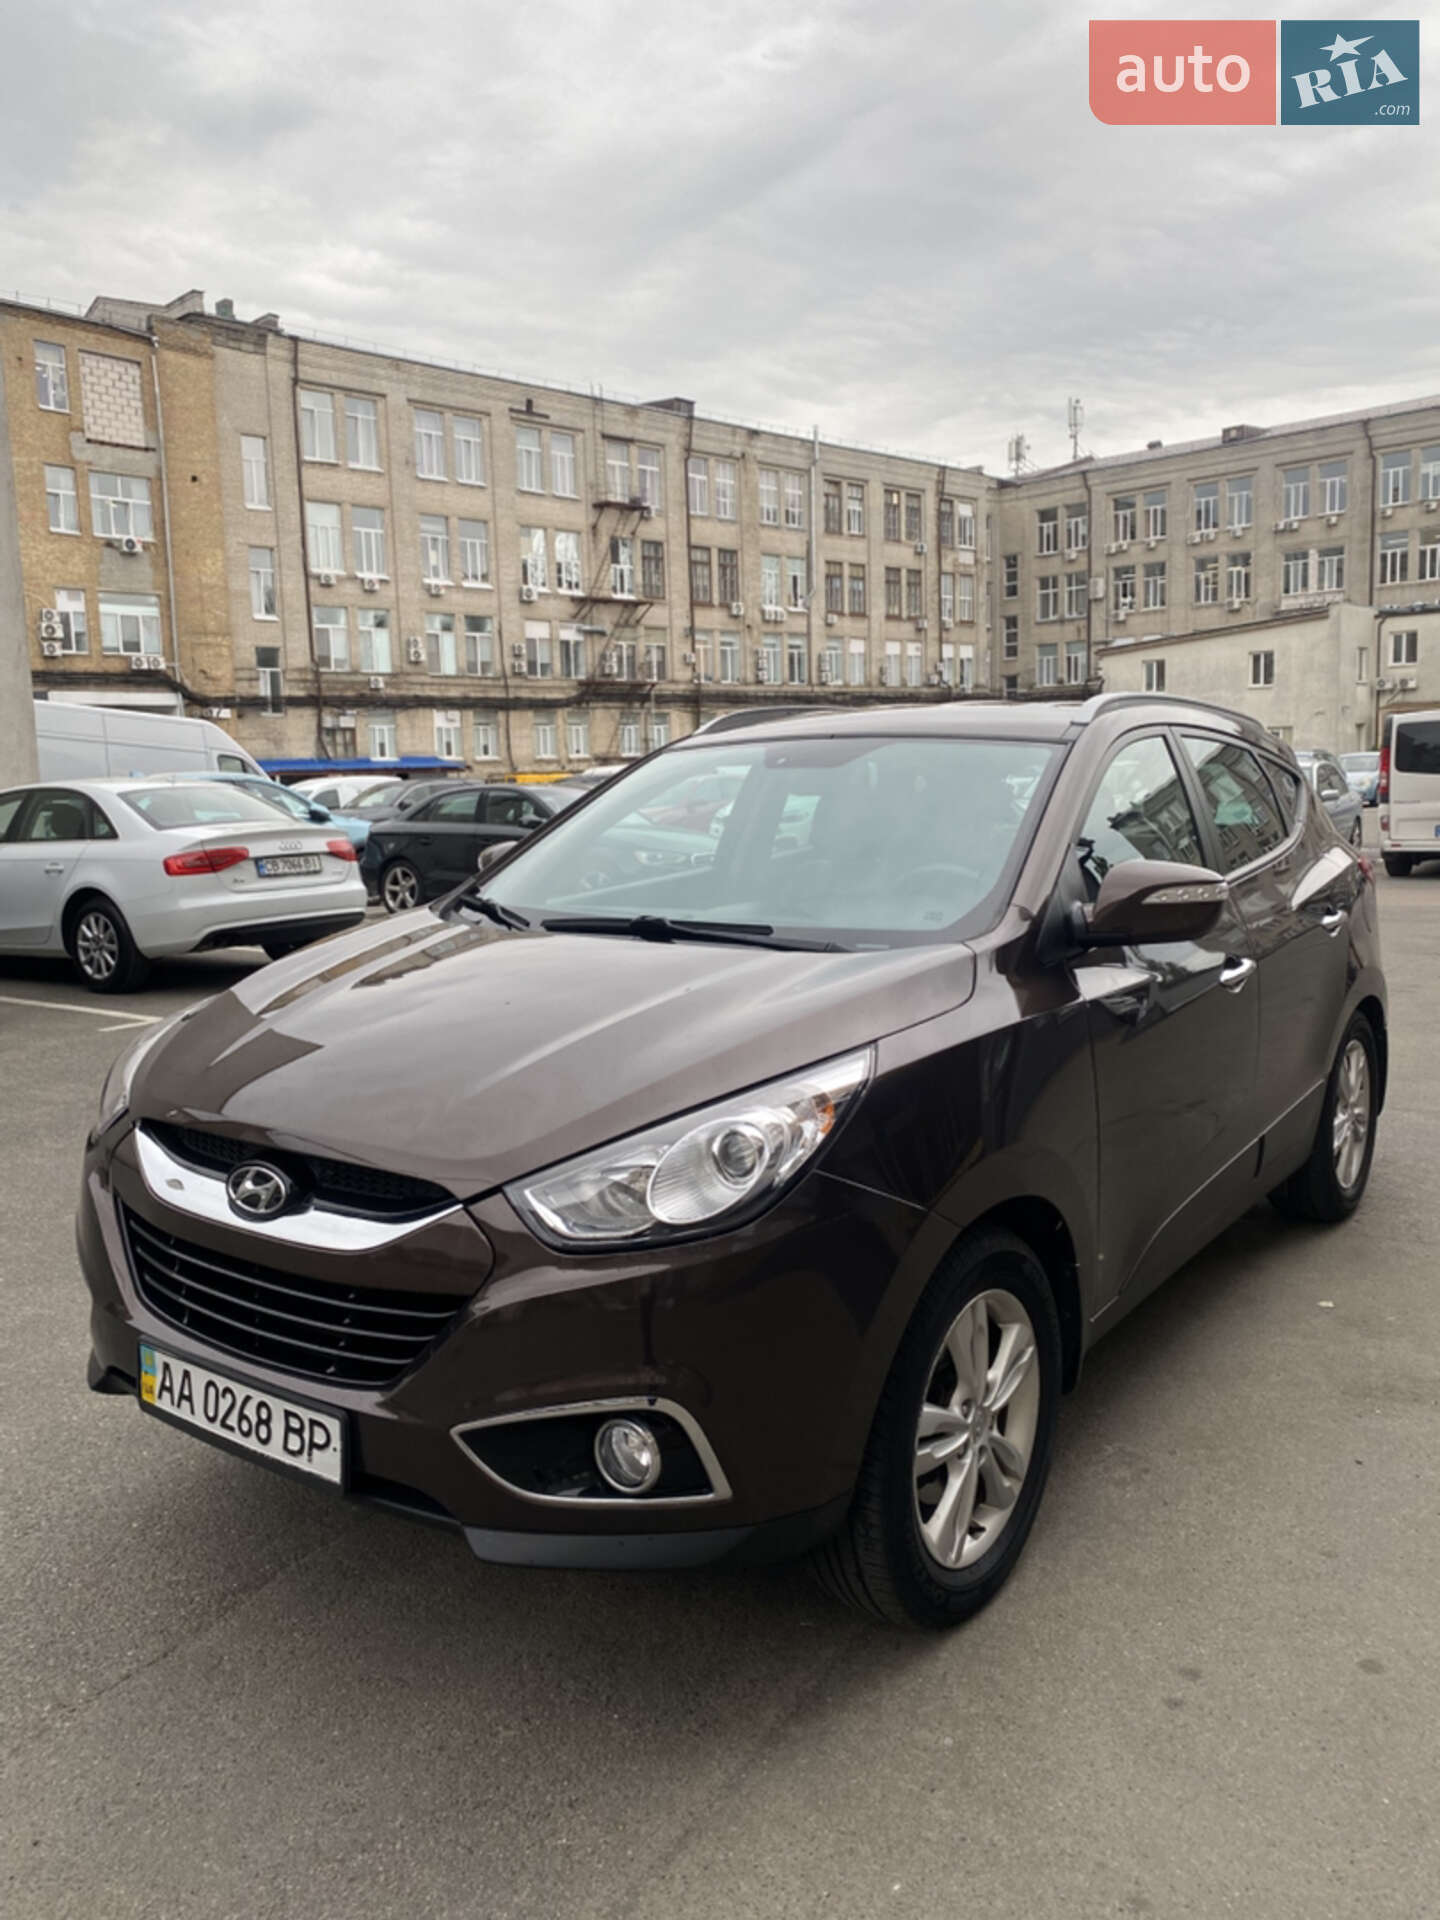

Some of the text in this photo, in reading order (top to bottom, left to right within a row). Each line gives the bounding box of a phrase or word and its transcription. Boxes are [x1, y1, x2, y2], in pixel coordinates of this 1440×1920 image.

[157, 1361, 332, 1463] AA 0268 BP
